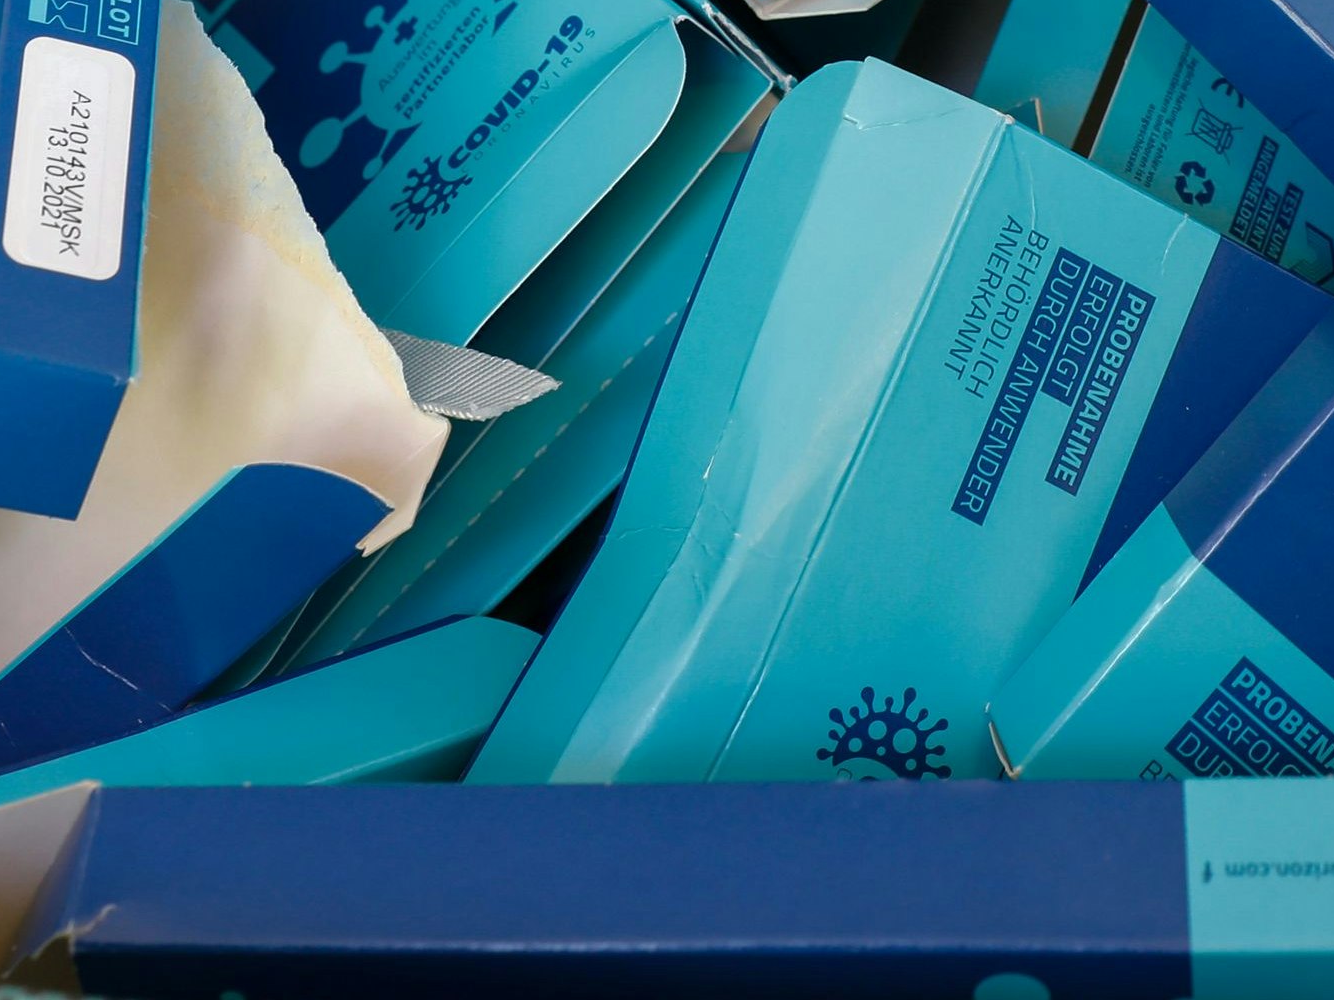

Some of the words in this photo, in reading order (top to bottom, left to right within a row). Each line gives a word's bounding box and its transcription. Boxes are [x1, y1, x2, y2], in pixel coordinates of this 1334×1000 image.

[394, 5, 481, 113] zertifizierten
[447, 14, 585, 170] COVID-19
[40, 125, 69, 230] 13.10.2021
[58, 89, 92, 258] A210143V/MSK
[1231, 139, 1277, 239] ANGEMELDET
[1250, 191, 1279, 252] PATENT
[1281, 186, 1303, 223] TEST
[943, 214, 1024, 381] ANERKANNT
[964, 229, 1050, 400] BEHÖRDLICH
[1026, 257, 1082, 354] DURCH
[1051, 275, 1114, 398] ERFOLGT
[960, 356, 1037, 515] ANWENDER
[1053, 291, 1149, 488] PROBENAHME
